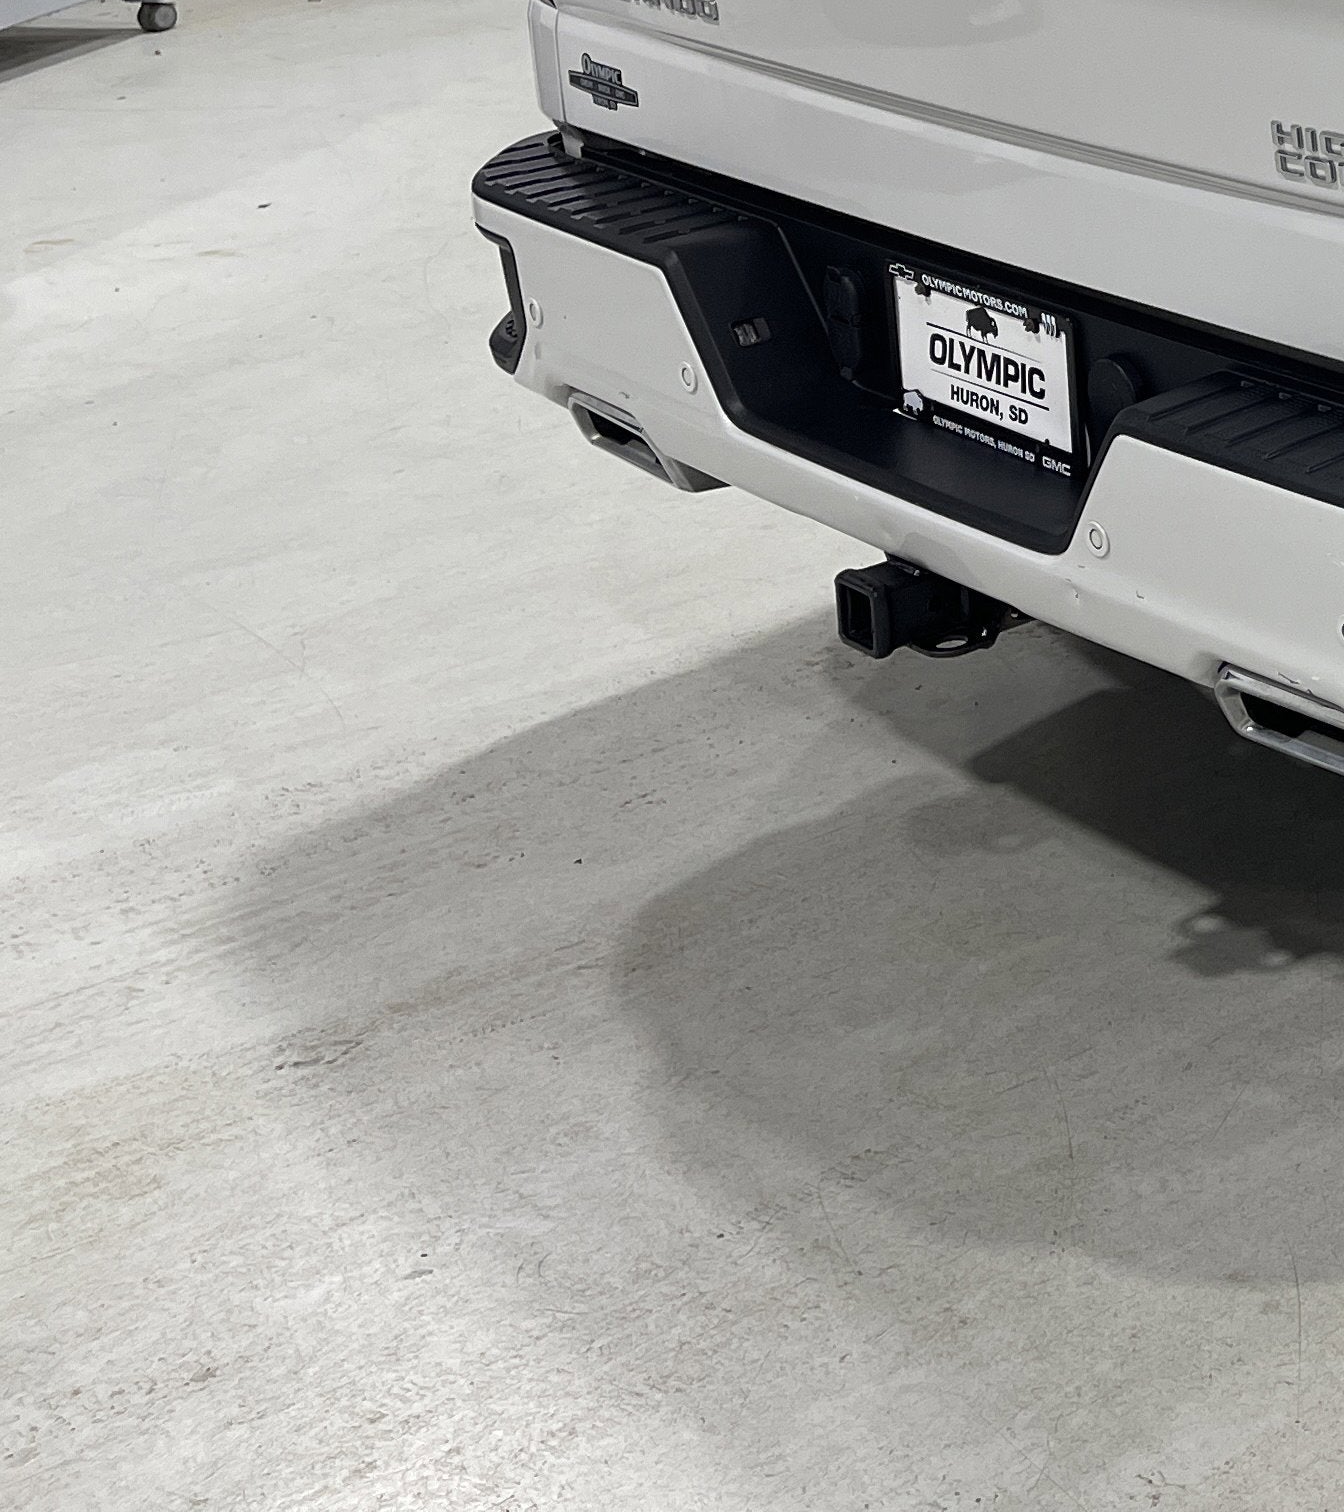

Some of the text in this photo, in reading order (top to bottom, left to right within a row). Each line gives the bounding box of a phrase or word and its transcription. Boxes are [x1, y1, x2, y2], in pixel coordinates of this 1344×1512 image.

[921, 273, 1029, 319] OLYMPICMOTORS.COM
[929, 332, 1046, 400] OLYMPIC
[932, 414, 963, 435] OLYMPIC
[950, 384, 1029, 426] HURON, SD
[1042, 455, 1072, 477] GMC
